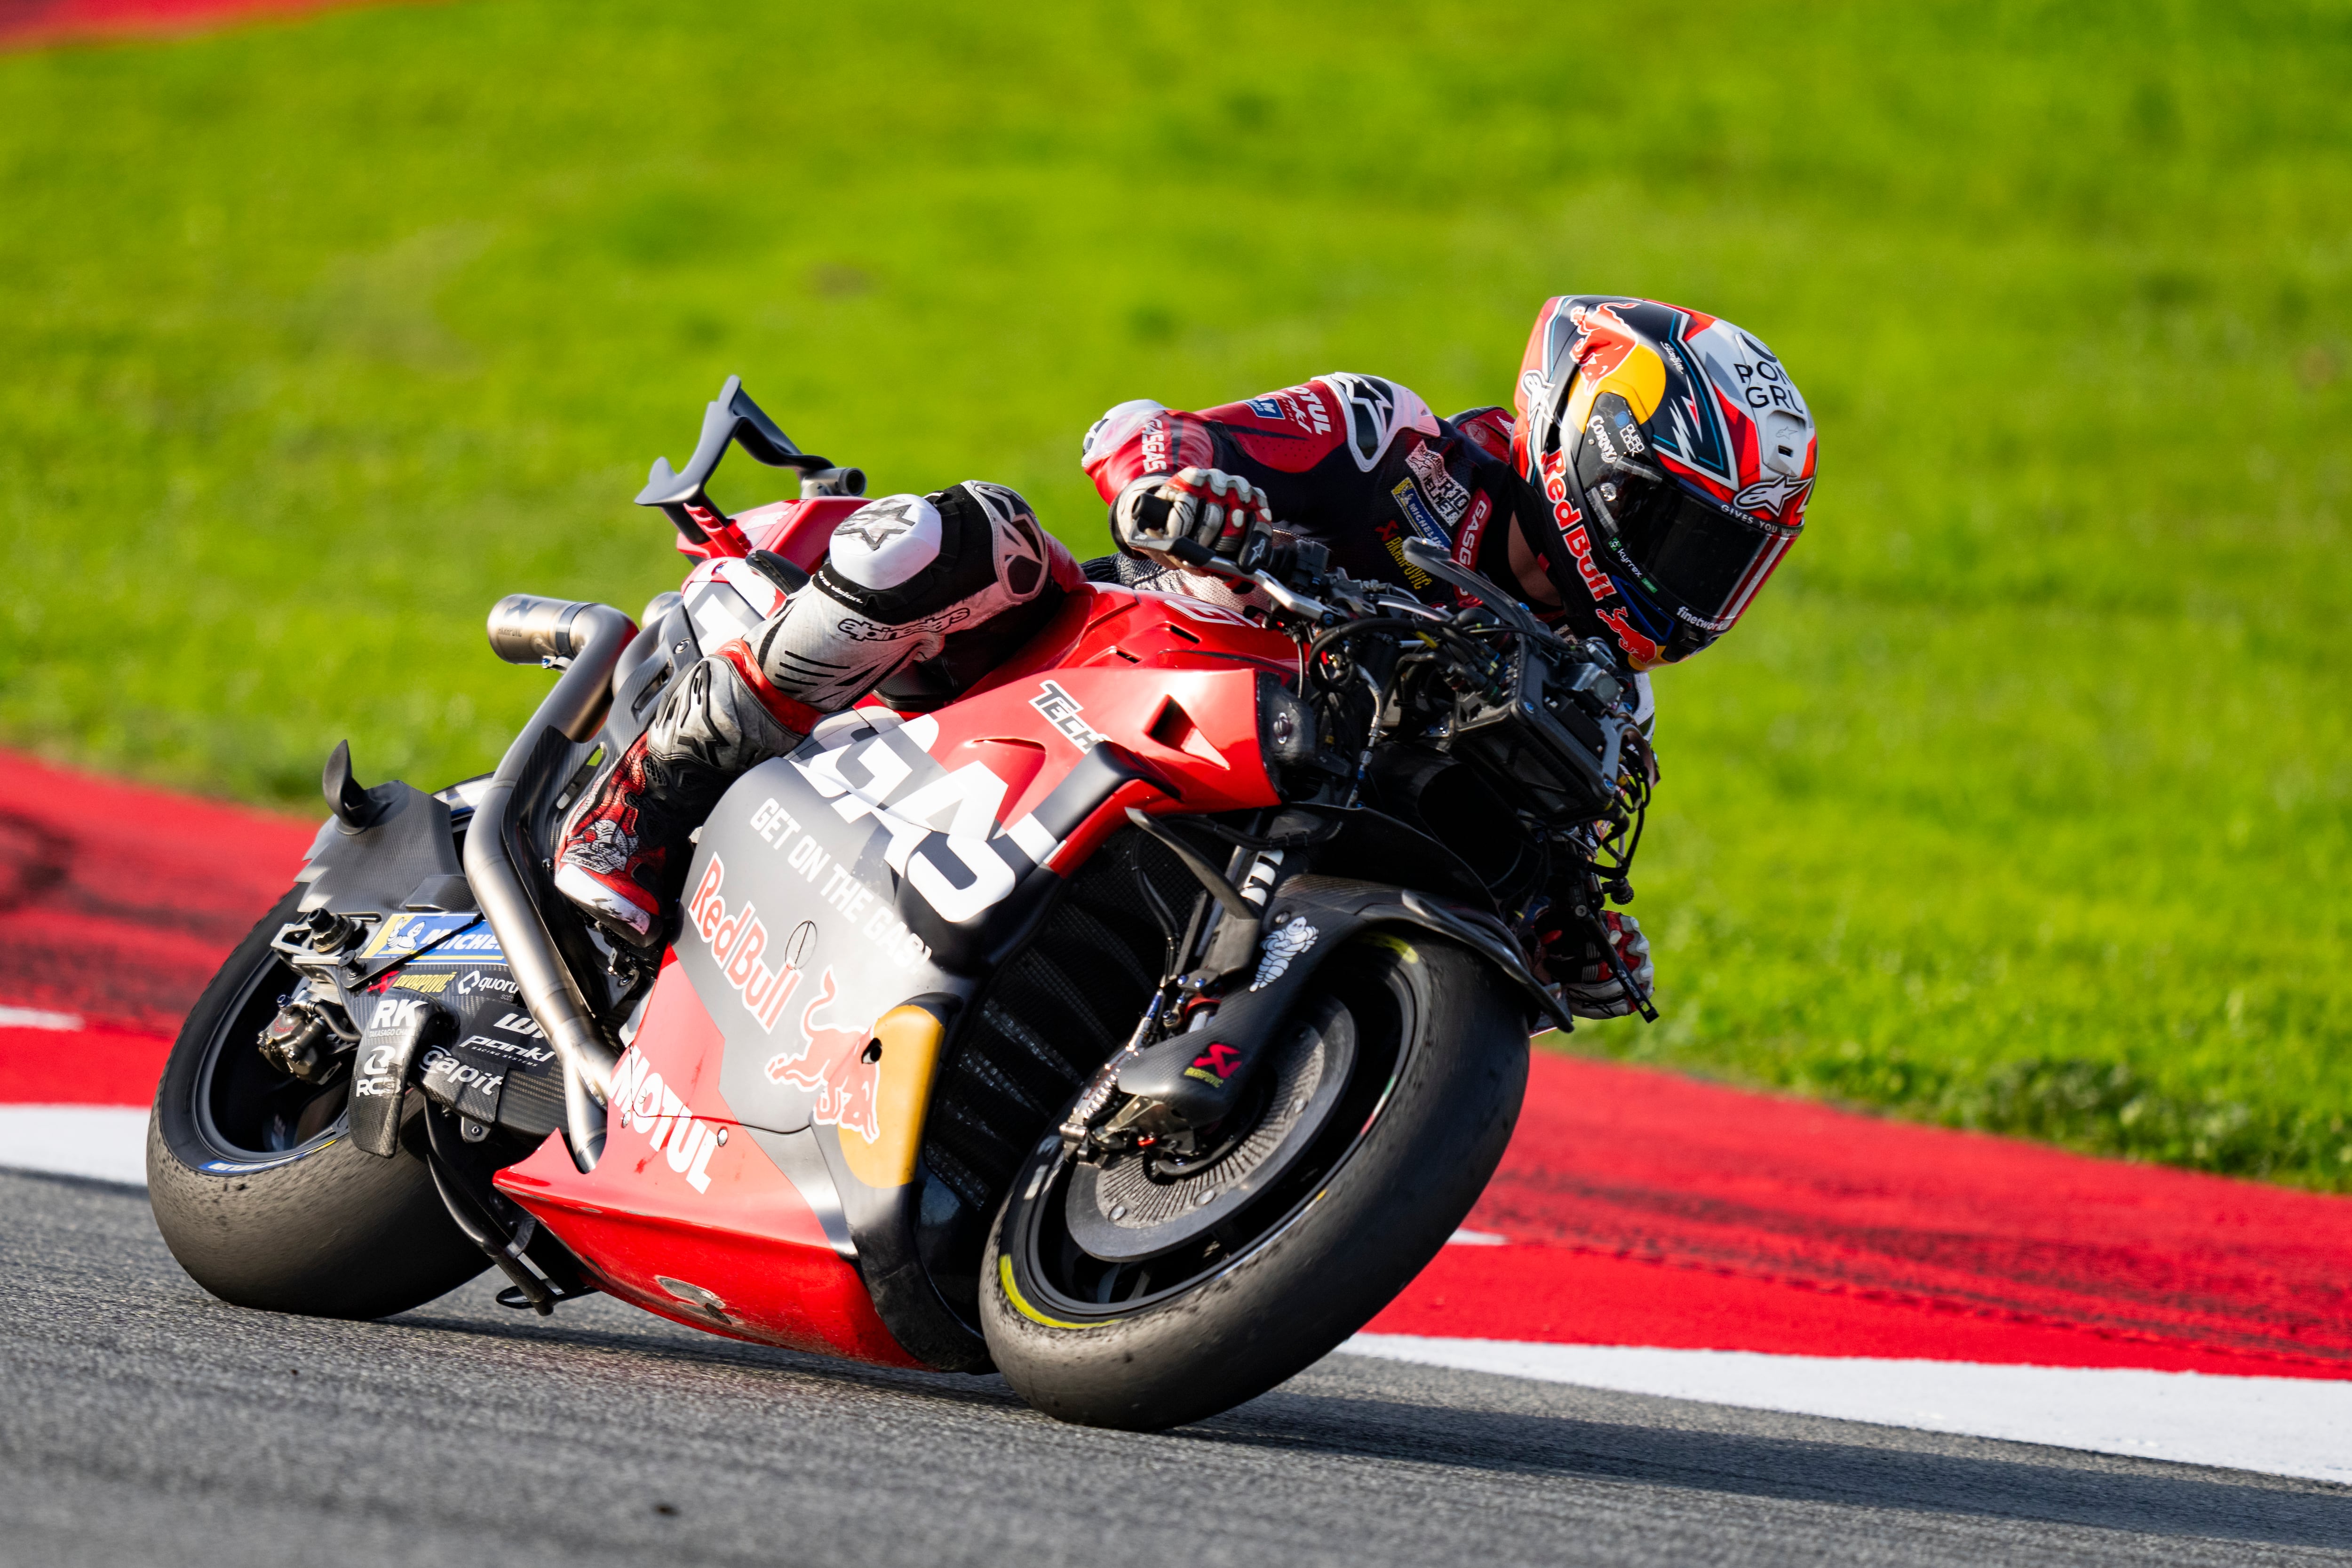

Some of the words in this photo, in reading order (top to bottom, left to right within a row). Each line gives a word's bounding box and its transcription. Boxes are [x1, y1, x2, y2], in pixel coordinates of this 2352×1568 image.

[1287, 387, 1331, 435] OTUL
[1142, 418, 1167, 472] GASGAS
[1620, 428, 1639, 457] LOCK
[1626, 424, 1645, 452] QUAD
[1541, 446, 1583, 531] Red
[1562, 525, 1617, 602] Bull
[1721, 504, 1754, 524] GIVES
[1759, 521, 1778, 533] YOU
[1617, 549, 1642, 578] kyrrex
[837, 607, 970, 641] alpinestars
[1677, 606, 1724, 630] finetwork
[1030, 680, 1103, 754] TECH
[750, 797, 802, 850] GET
[787, 835, 831, 883] ON
[820, 863, 874, 923] THE
[420, 929, 501, 950] MICHE
[688, 851, 756, 970] Red
[723, 916, 804, 1035] Bull
[478, 977, 519, 995] quoru
[500, 994, 515, 1003] soft
[371, 999, 429, 1029] RK
[369, 1029, 395, 1038] TAKASAGO
[459, 1035, 555, 1062] pankl
[471, 1046, 500, 1056] RACING
[502, 1055, 538, 1067] SYSTEMS
[423, 1050, 504, 1096] capit
[608, 1044, 718, 1194] MOTUL
